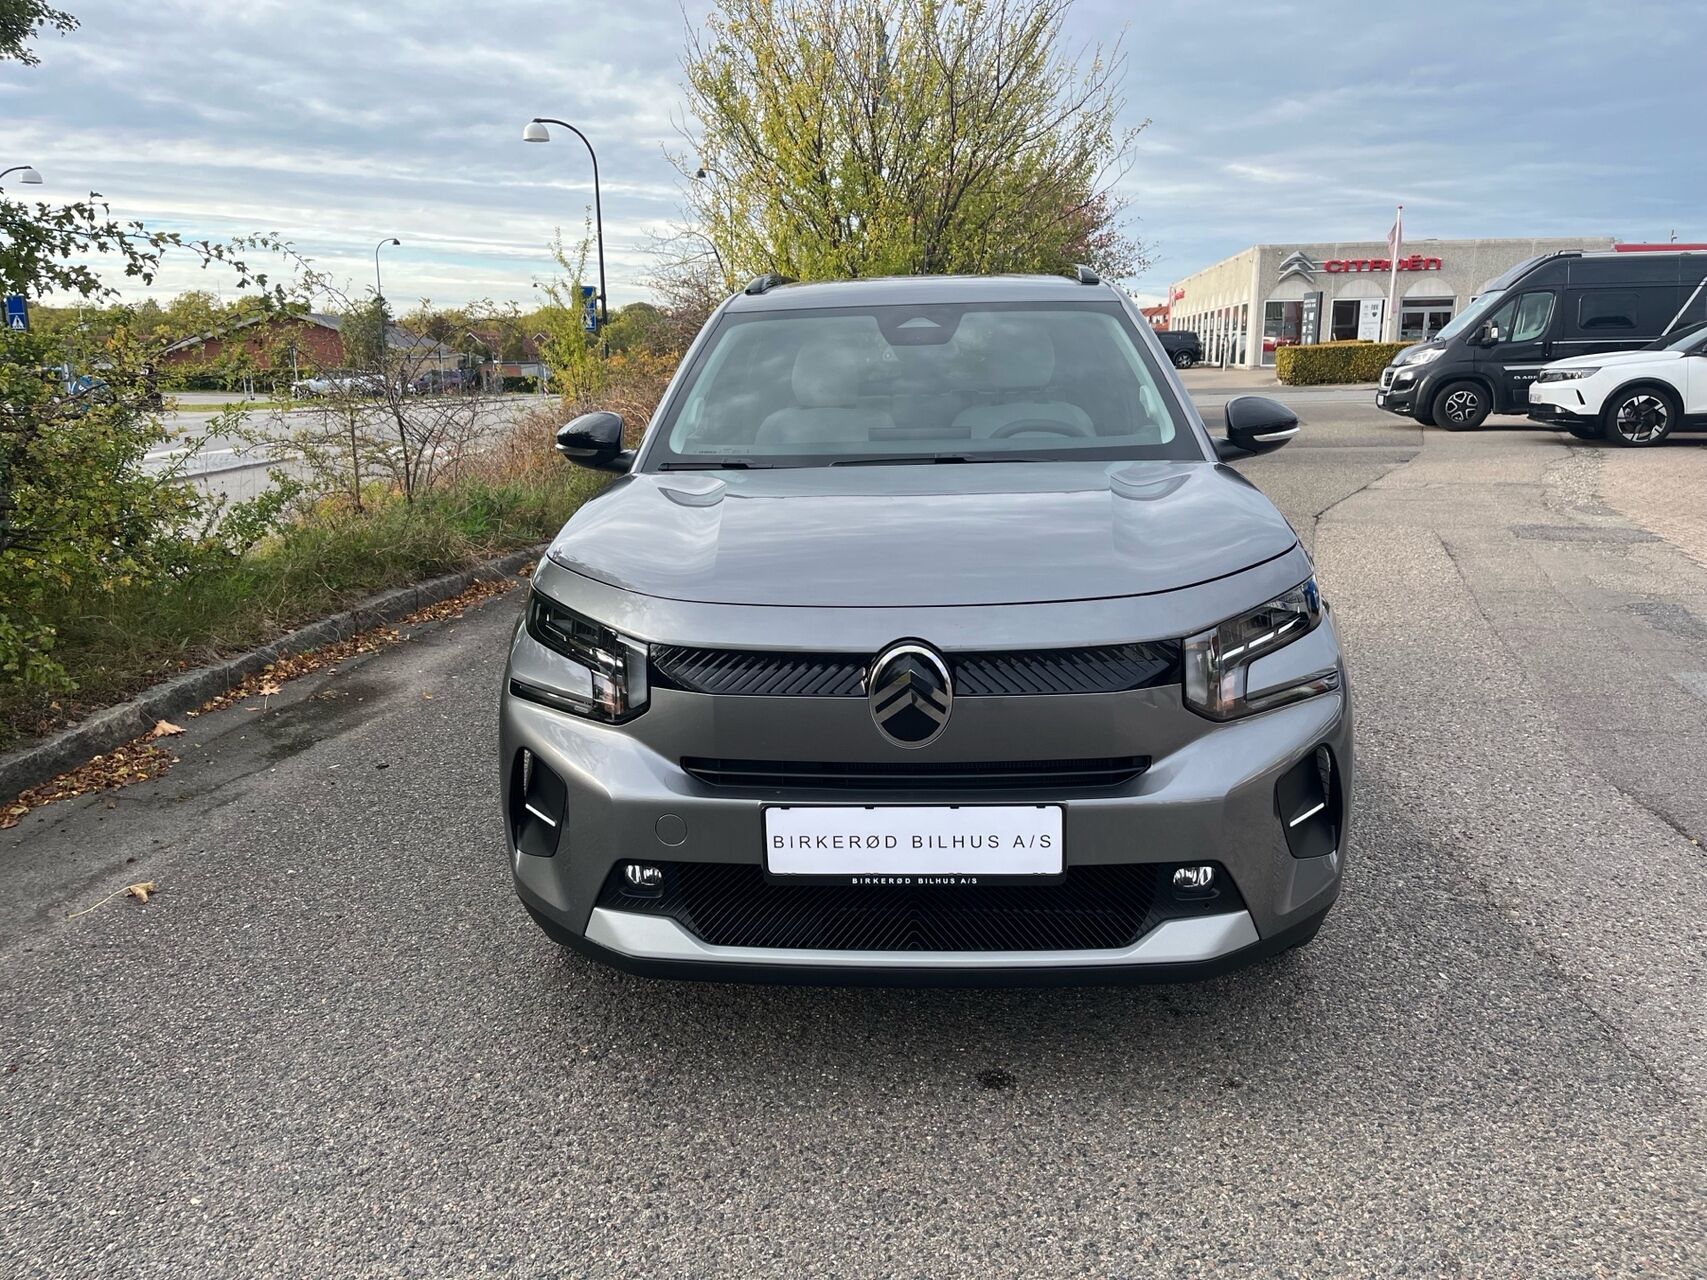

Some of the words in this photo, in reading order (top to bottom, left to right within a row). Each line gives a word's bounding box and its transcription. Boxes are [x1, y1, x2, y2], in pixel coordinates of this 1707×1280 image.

[773, 835, 898, 849] BIRKERØD
[912, 835, 1000, 849] BILHUS
[1012, 834, 1052, 849] A/S
[852, 877, 912, 885] BIRKERØD
[917, 877, 956, 885] BILHUS
[960, 877, 978, 885] A/S
